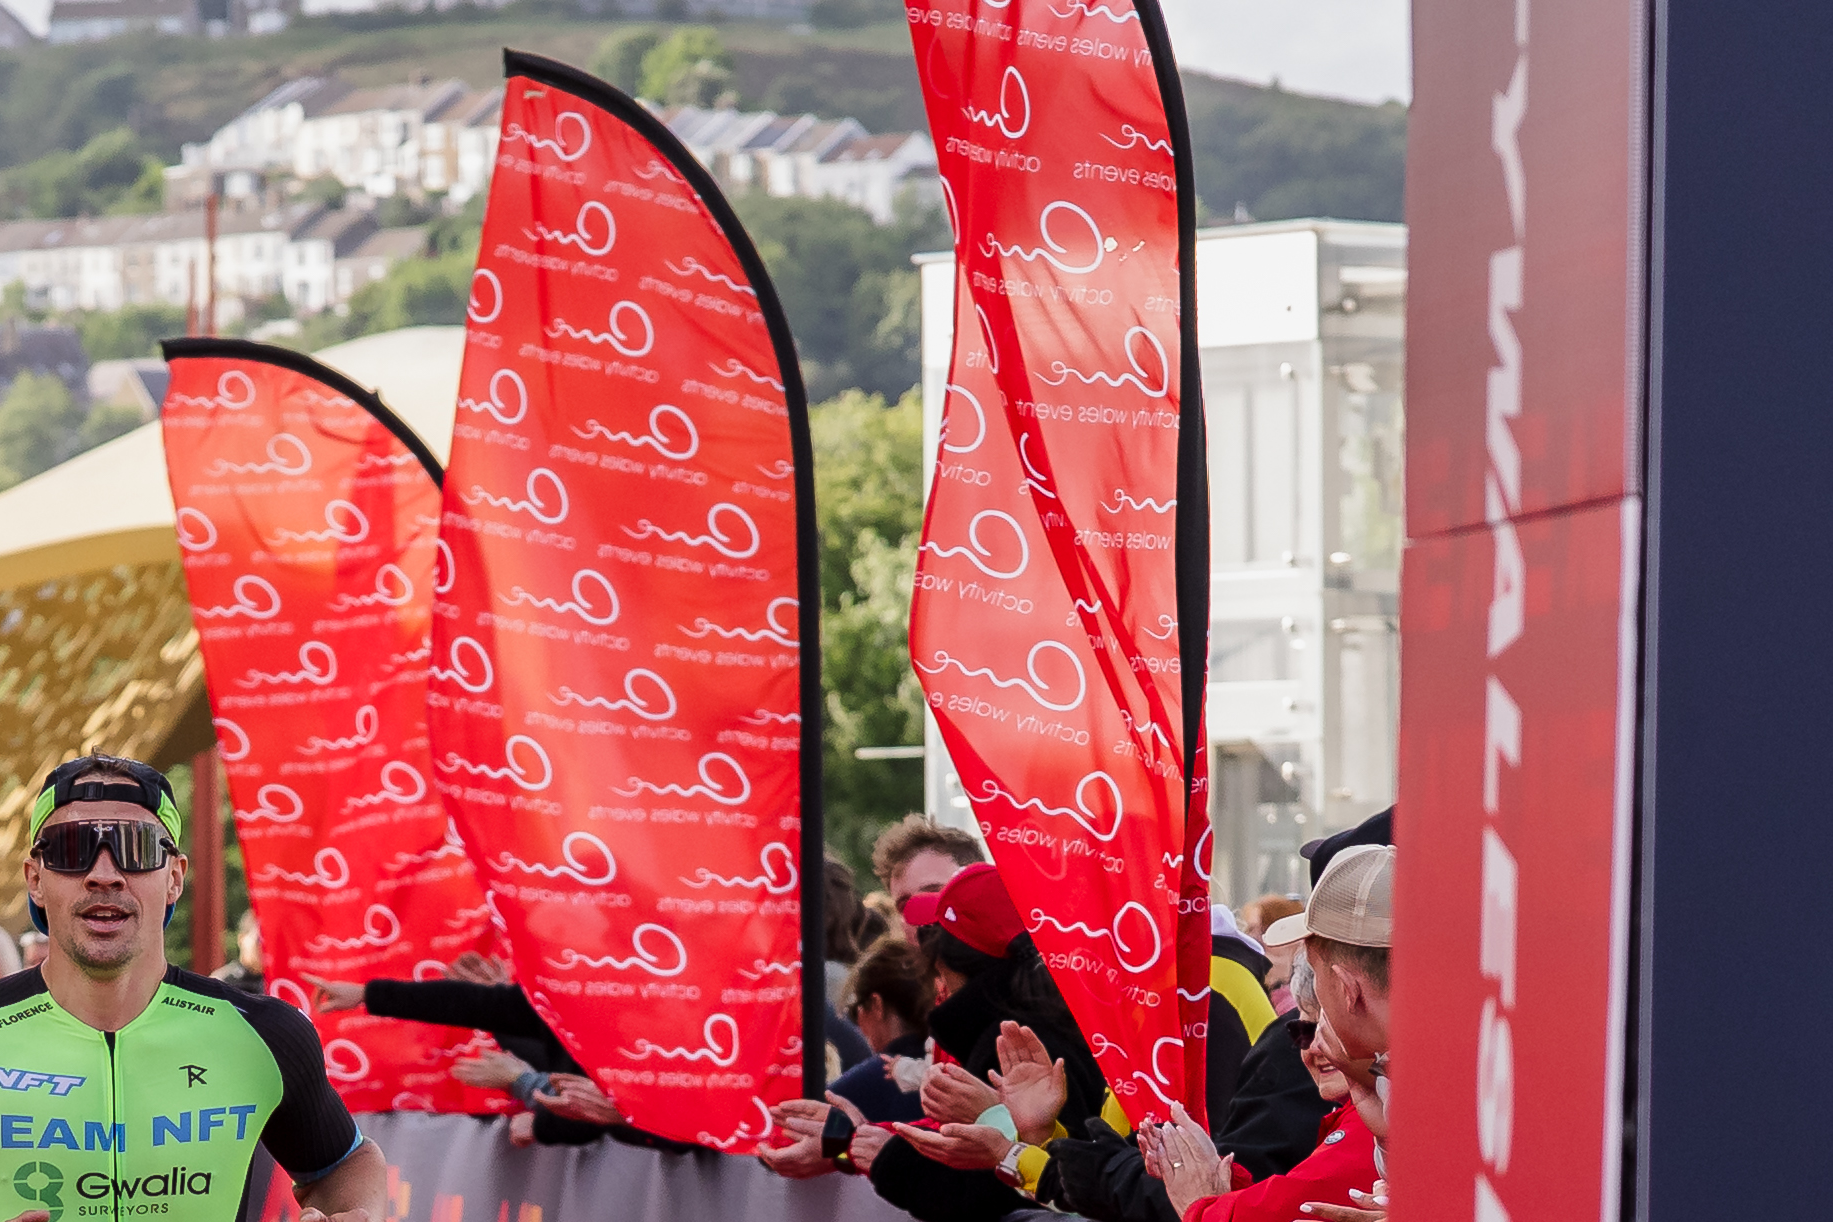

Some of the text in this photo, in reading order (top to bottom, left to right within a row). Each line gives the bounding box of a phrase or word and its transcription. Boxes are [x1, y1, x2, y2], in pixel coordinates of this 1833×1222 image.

[161, 996, 216, 1016] ALISTAIR
[152, 1104, 257, 1146] NFT
[76, 1166, 212, 1199] Gwalia
[78, 1203, 170, 1217] SURVEYORS
